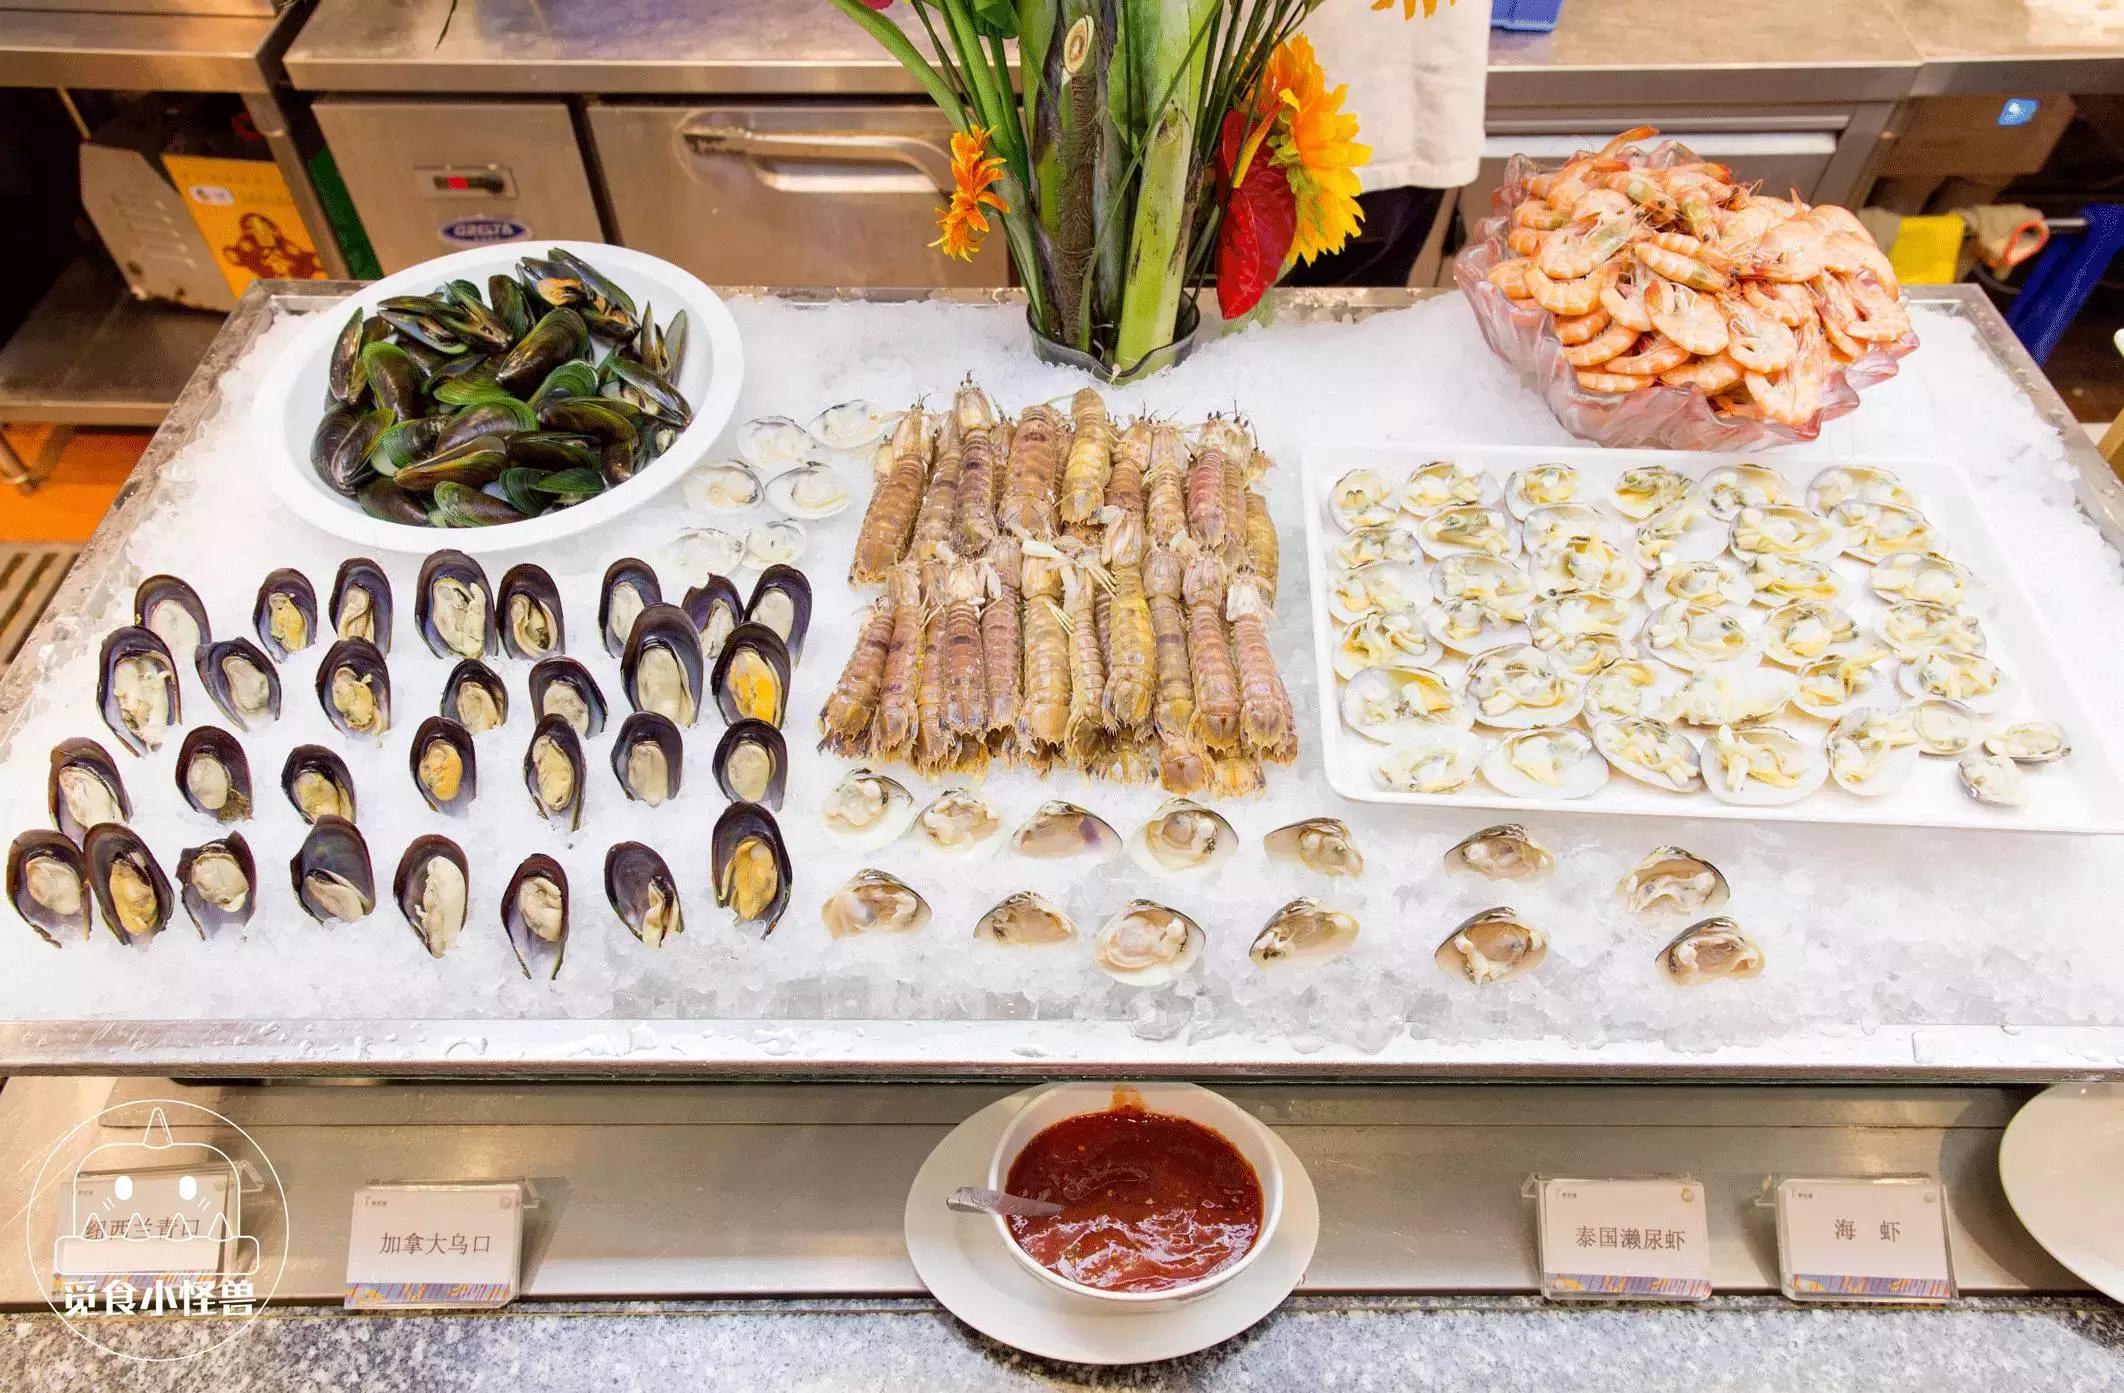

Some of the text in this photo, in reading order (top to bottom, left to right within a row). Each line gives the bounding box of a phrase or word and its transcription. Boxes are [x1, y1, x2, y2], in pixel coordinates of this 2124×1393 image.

[379, 1231, 492, 1256] 加拿大乌口
[1575, 1225, 1686, 1251] 泰国濑尿虾
